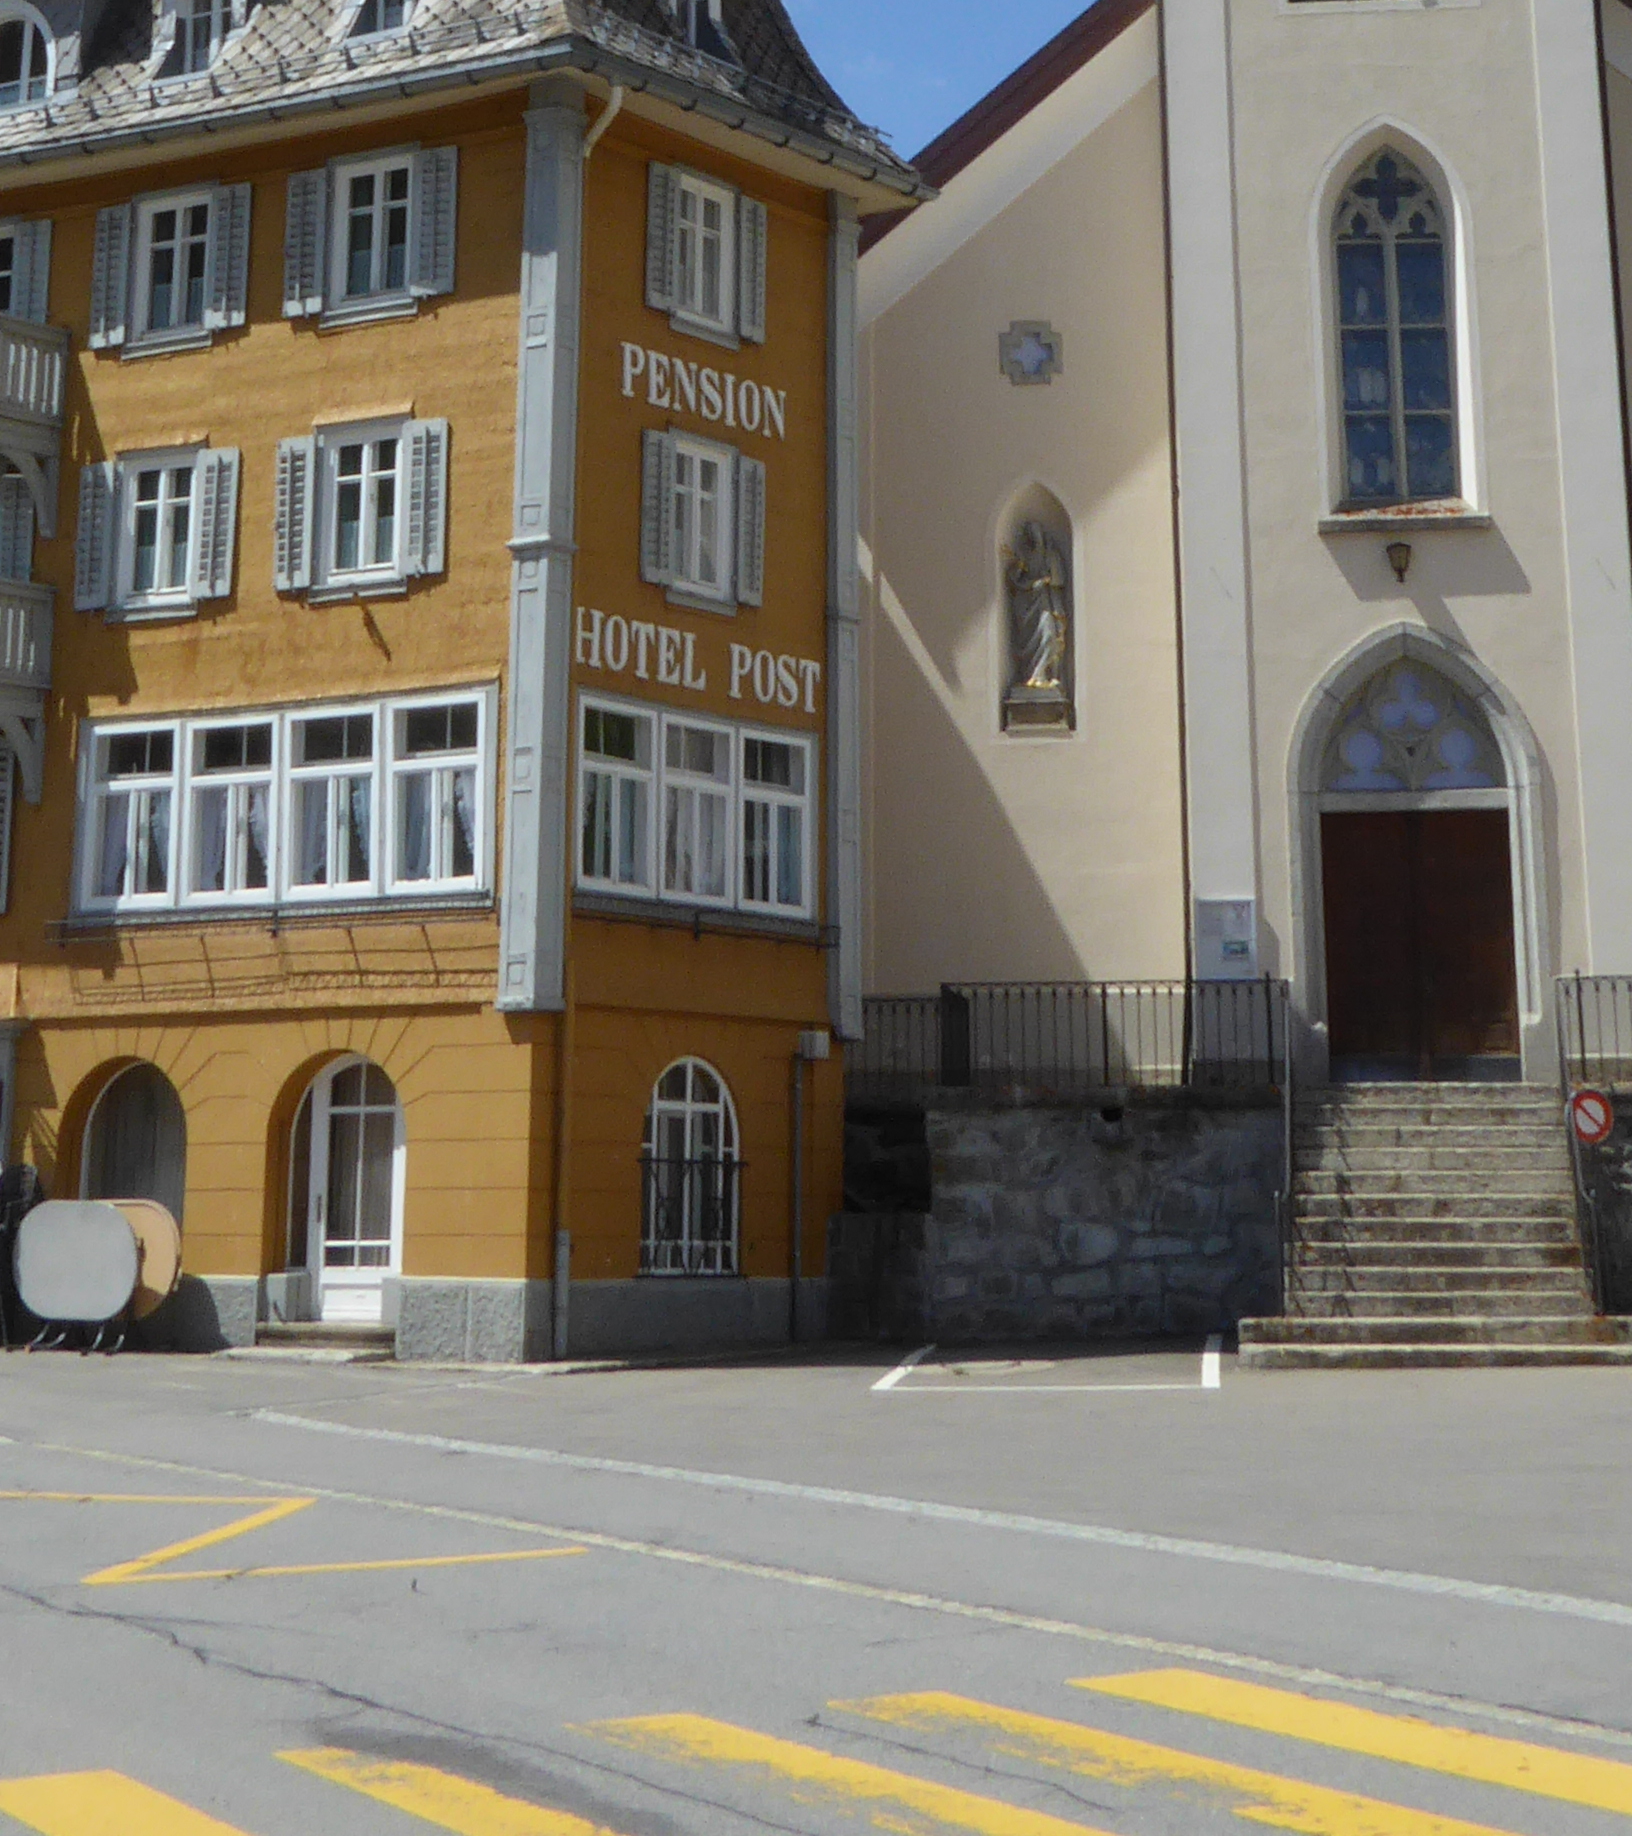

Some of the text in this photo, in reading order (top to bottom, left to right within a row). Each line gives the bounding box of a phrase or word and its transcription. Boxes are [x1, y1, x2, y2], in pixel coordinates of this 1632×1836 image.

[620, 341, 787, 441] PENSION
[575, 606, 820, 714] HOTEL POST
